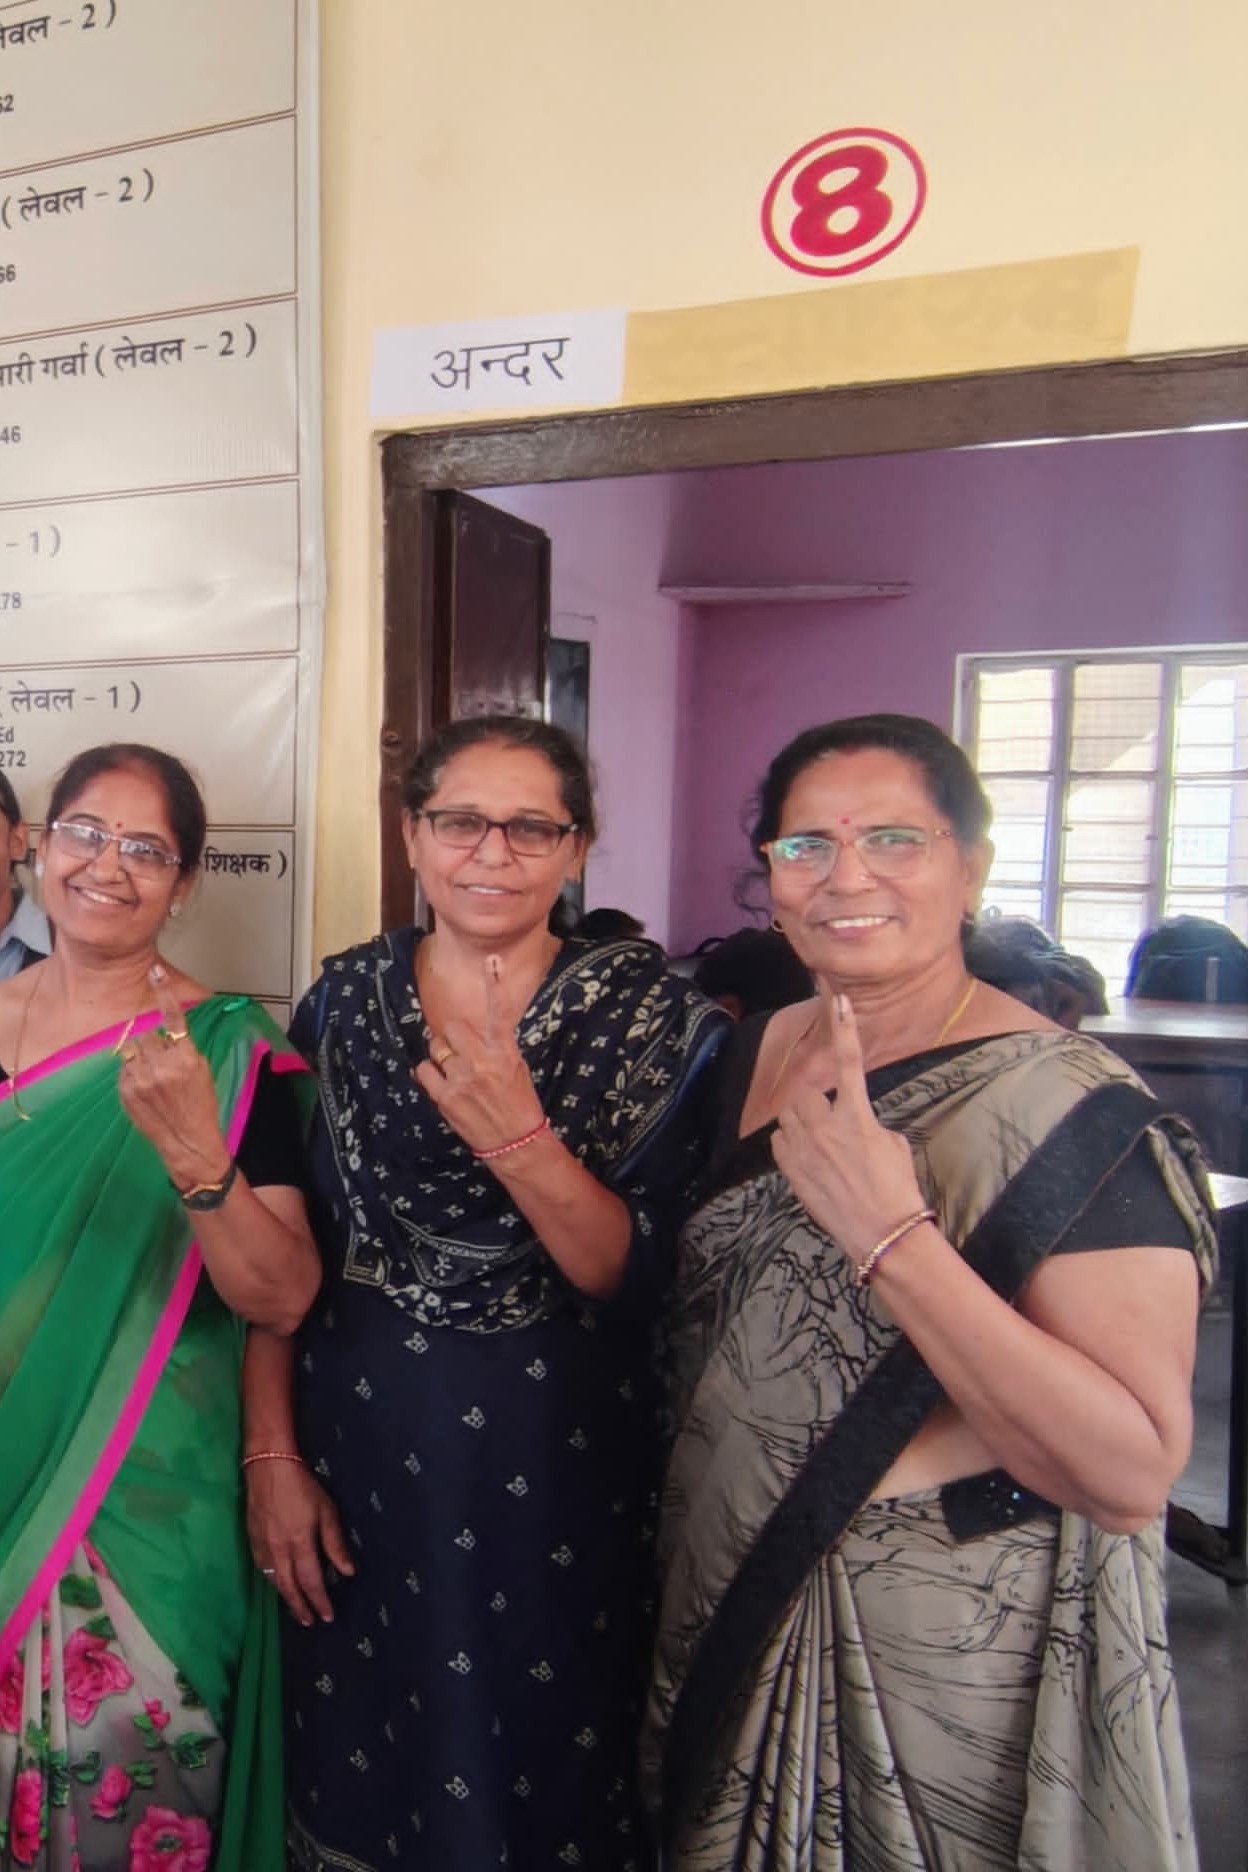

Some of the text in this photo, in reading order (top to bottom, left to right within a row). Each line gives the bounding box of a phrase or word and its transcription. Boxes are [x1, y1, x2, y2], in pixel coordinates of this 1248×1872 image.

[81, 3, 96, 30] 2
[19, 186, 87, 222] लेवल
[118, 176, 133, 203] 2
[789, 144, 893, 257] 8
[112, 335, 185, 371] लेवल
[218, 330, 235, 357] 2
[429, 335, 571, 394] अन्दर
[29, 531, 40, 554] 1
[9, 681, 75, 714] लेवल
[107, 685, 119, 709] 1
